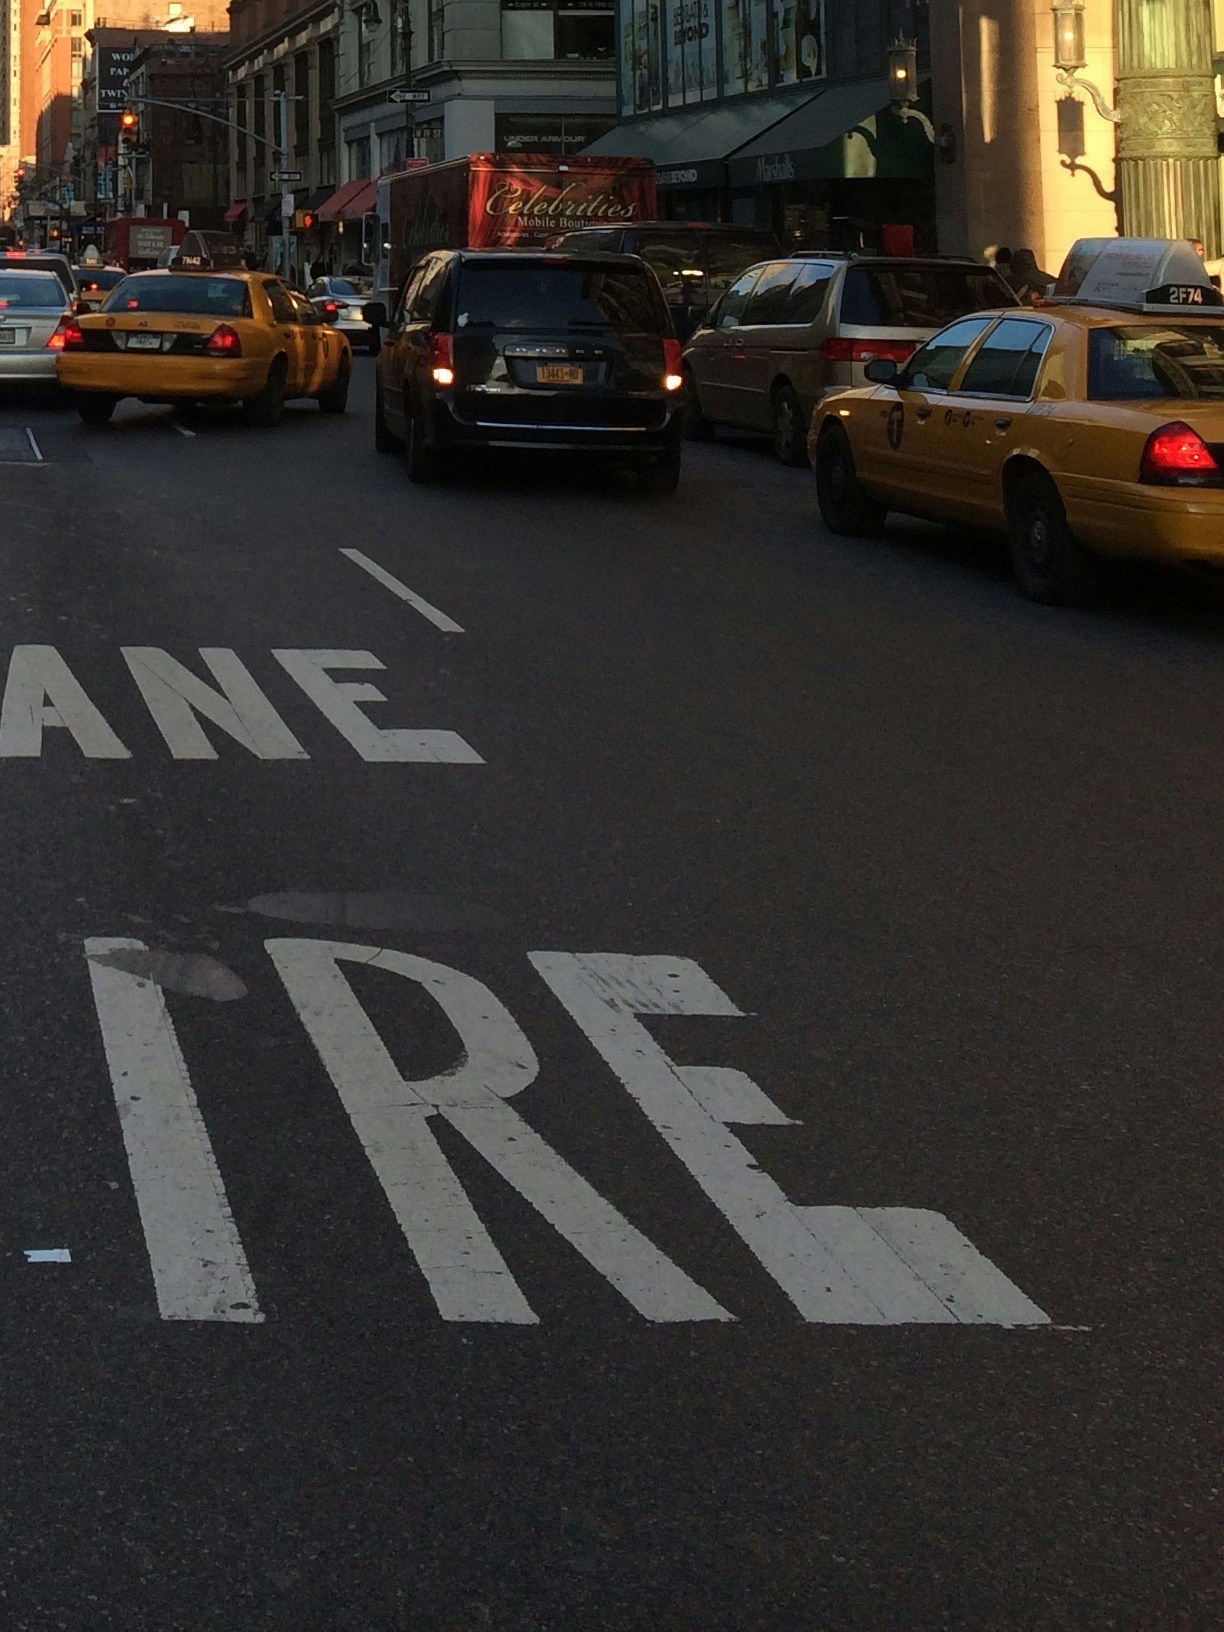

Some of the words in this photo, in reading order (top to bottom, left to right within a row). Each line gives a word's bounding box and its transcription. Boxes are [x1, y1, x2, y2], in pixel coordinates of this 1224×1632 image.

[433, 129, 442, 138] ST
[541, 135, 586, 143] ARMOUR
[486, 181, 638, 217] Celebrities
[517, 216, 556, 227] Mobile
[560, 217, 602, 228] Boutiq
[1169, 287, 1203, 304] 2F74
